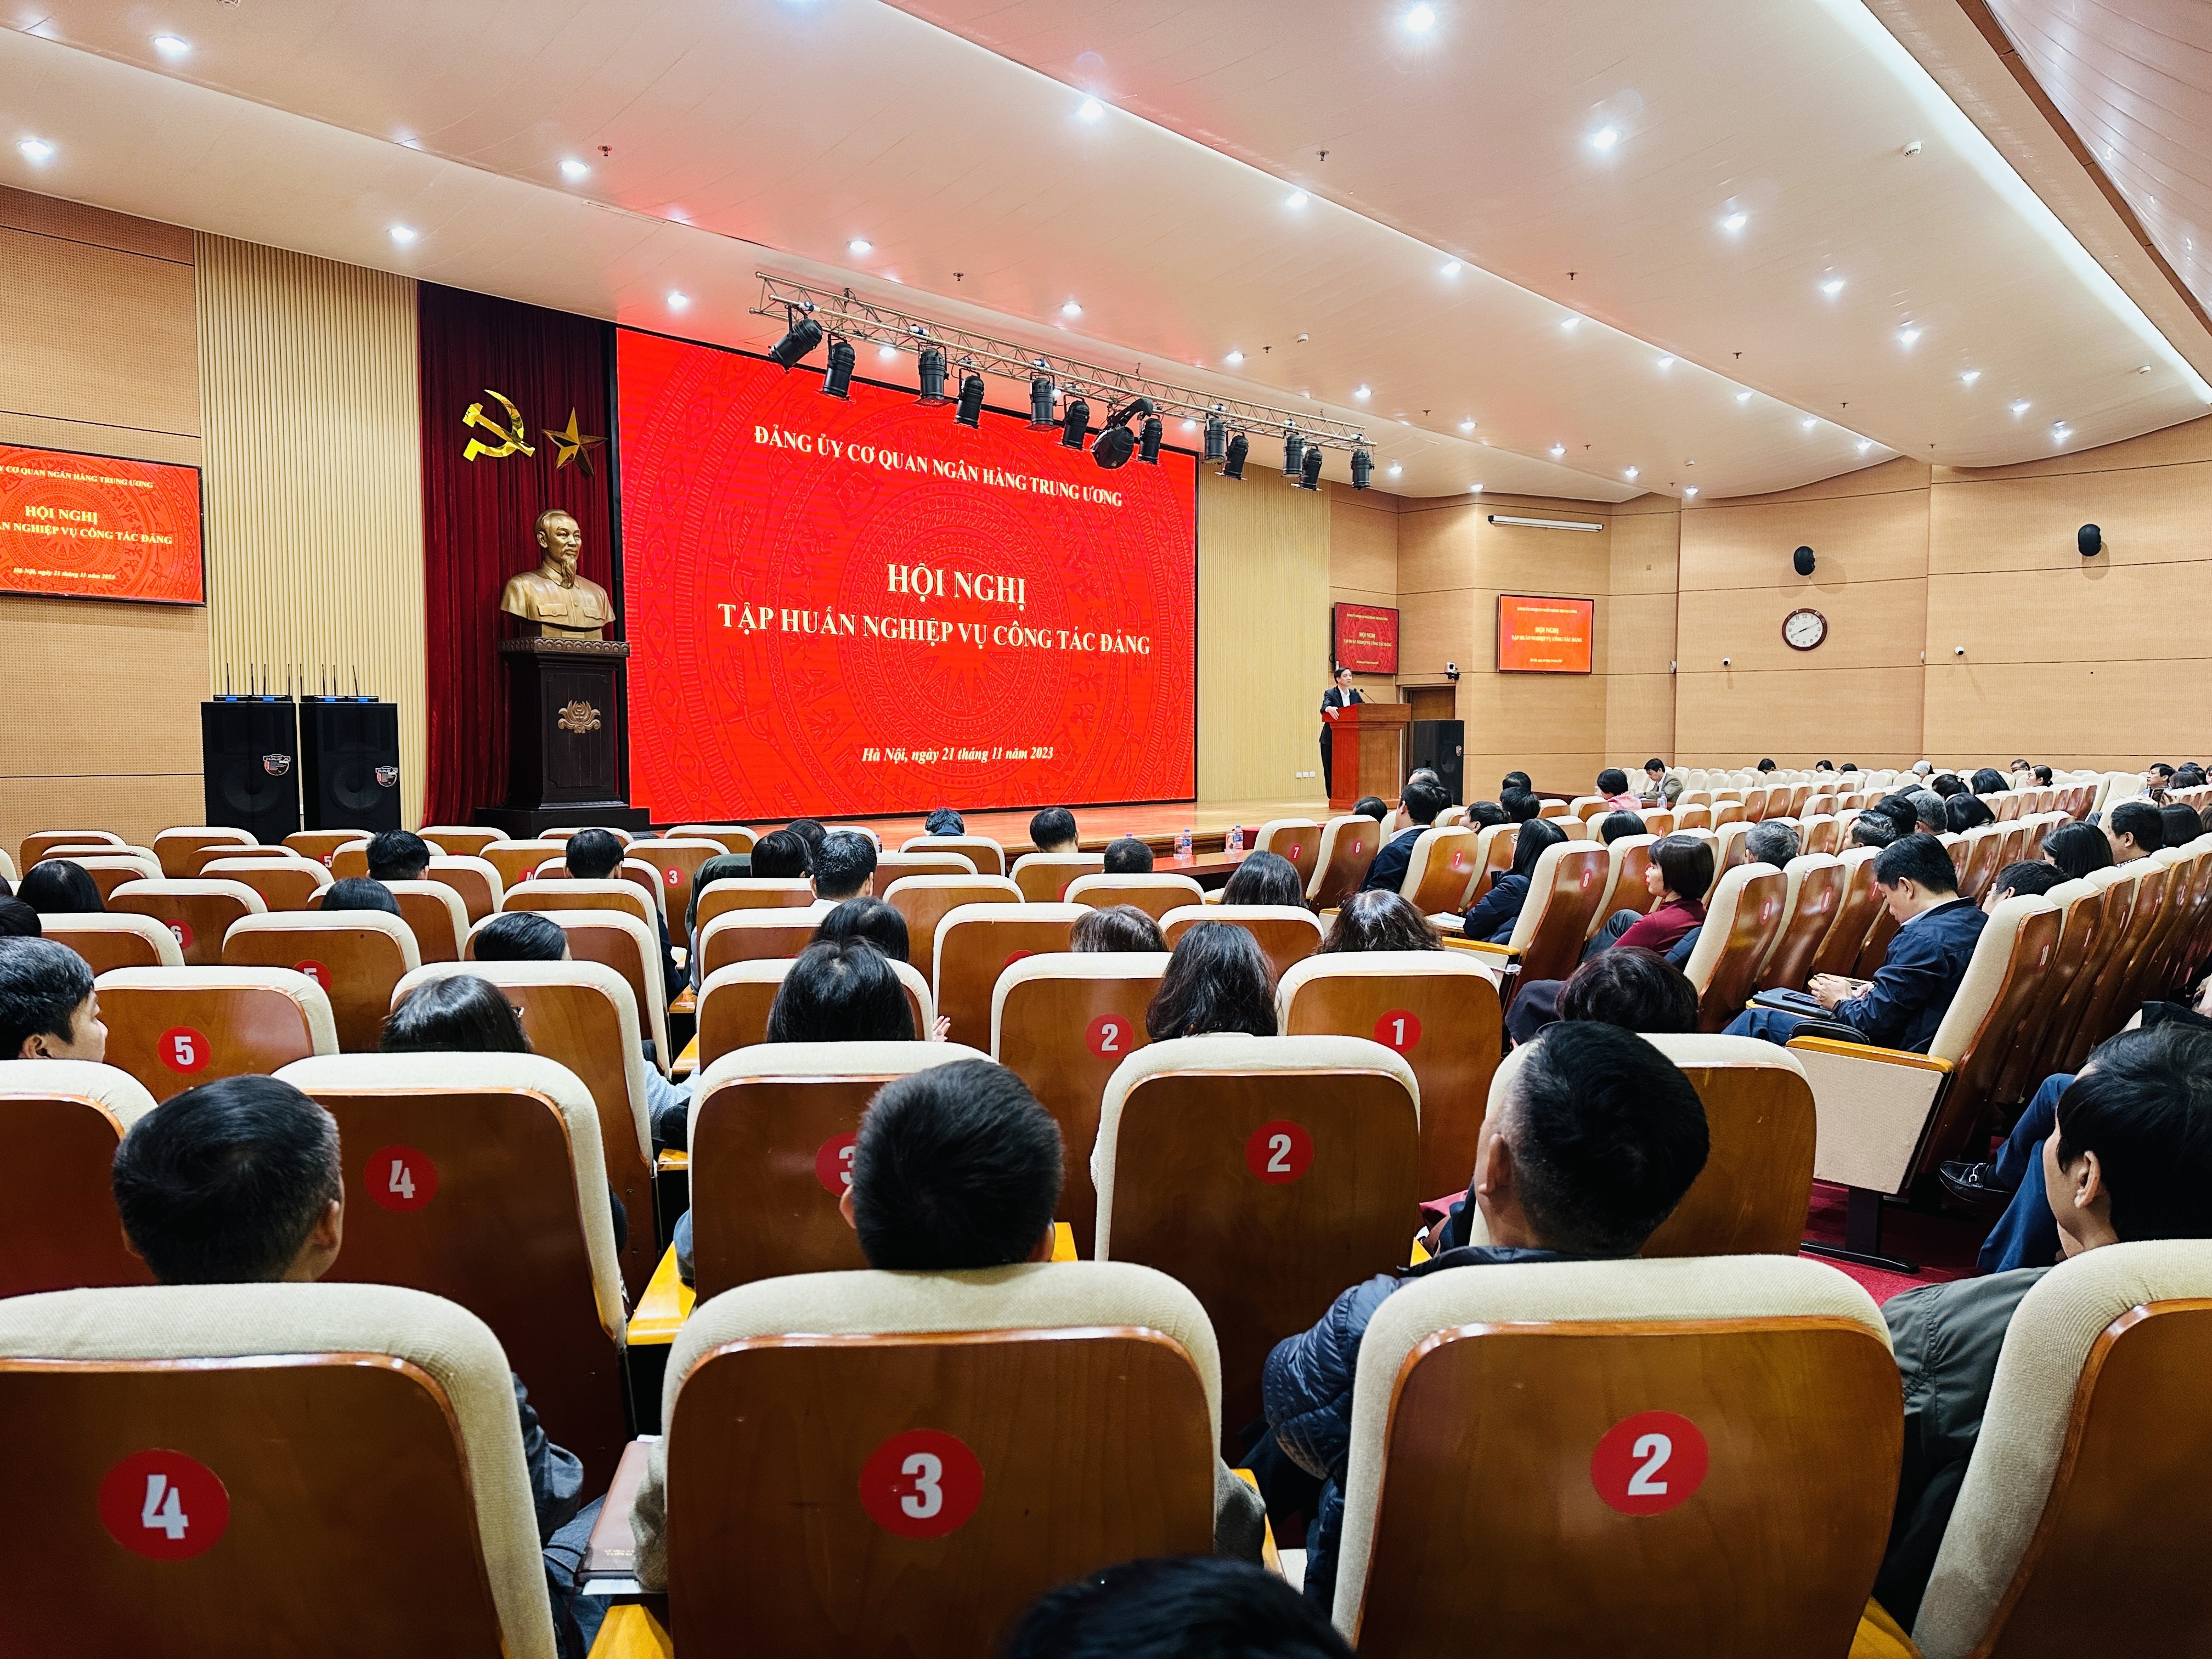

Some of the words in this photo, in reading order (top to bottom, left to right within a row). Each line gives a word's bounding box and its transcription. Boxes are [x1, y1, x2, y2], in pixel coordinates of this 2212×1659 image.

[20, 467, 46, 476] QUAN
[47, 470, 71, 479] NGÂN
[73, 473, 98, 482] HÀNG
[99, 476, 128, 486] TRUNG
[129, 479, 153, 488] ƯƠNG
[754, 424, 812, 453] ĐẢNG
[817, 433, 843, 458] ỦY
[847, 444, 875, 464] CƠ
[878, 449, 928, 473] QUAN
[933, 459, 978, 482] NGÂN
[983, 467, 1026, 490] HÀNG
[1029, 477, 1079, 499] TRUNG
[1083, 486, 1122, 507] ƯƠNG
[25, 505, 54, 521] HỘI
[58, 509, 98, 525] NGHỊ
[13, 523, 59, 536] NGHIỆP
[61, 527, 77, 538] VỤ
[80, 527, 114, 539] CÔNG
[115, 531, 139, 541] TÁC
[140, 533, 172, 545] ĐẢNG
[887, 562, 945, 602] HỘI
[953, 571, 1026, 611] NGHỊ
[718, 602, 774, 635] TẬP
[780, 606, 856, 636] HUẤN
[862, 617, 953, 647] NGHIỆP
[957, 623, 988, 650] VỤ
[993, 620, 1052, 648] CÔNG
[1057, 626, 1096, 651] TÁC
[1100, 629, 1150, 654] ĐẢNG
[861, 748, 881, 761] Hà
[883, 747, 908, 764] Nội,
[911, 747, 939, 764] ngày
[941, 747, 955, 760] 21
[957, 747, 989, 763] tháng
[992, 747, 1002, 760] 11
[1005, 747, 1028, 760] năm
[1030, 746, 1054, 759] 2023
[1293, 847, 1300, 859] 7
[1355, 842, 1361, 853] 6
[323, 855, 332, 868] 5
[669, 870, 678, 884] 3
[1583, 872, 1590, 888] 8
[1763, 902, 1770, 920] 9
[1101, 1023, 1118, 1051] 2
[1392, 1019, 1404, 1046] 1
[174, 1036, 195, 1065] 5
[1267, 1134, 1291, 1172] 2
[388, 1160, 416, 1199] 4
[1628, 1433, 1672, 1496] 2
[901, 1453, 943, 1519] 3
[142, 1474, 189, 1539] 4
